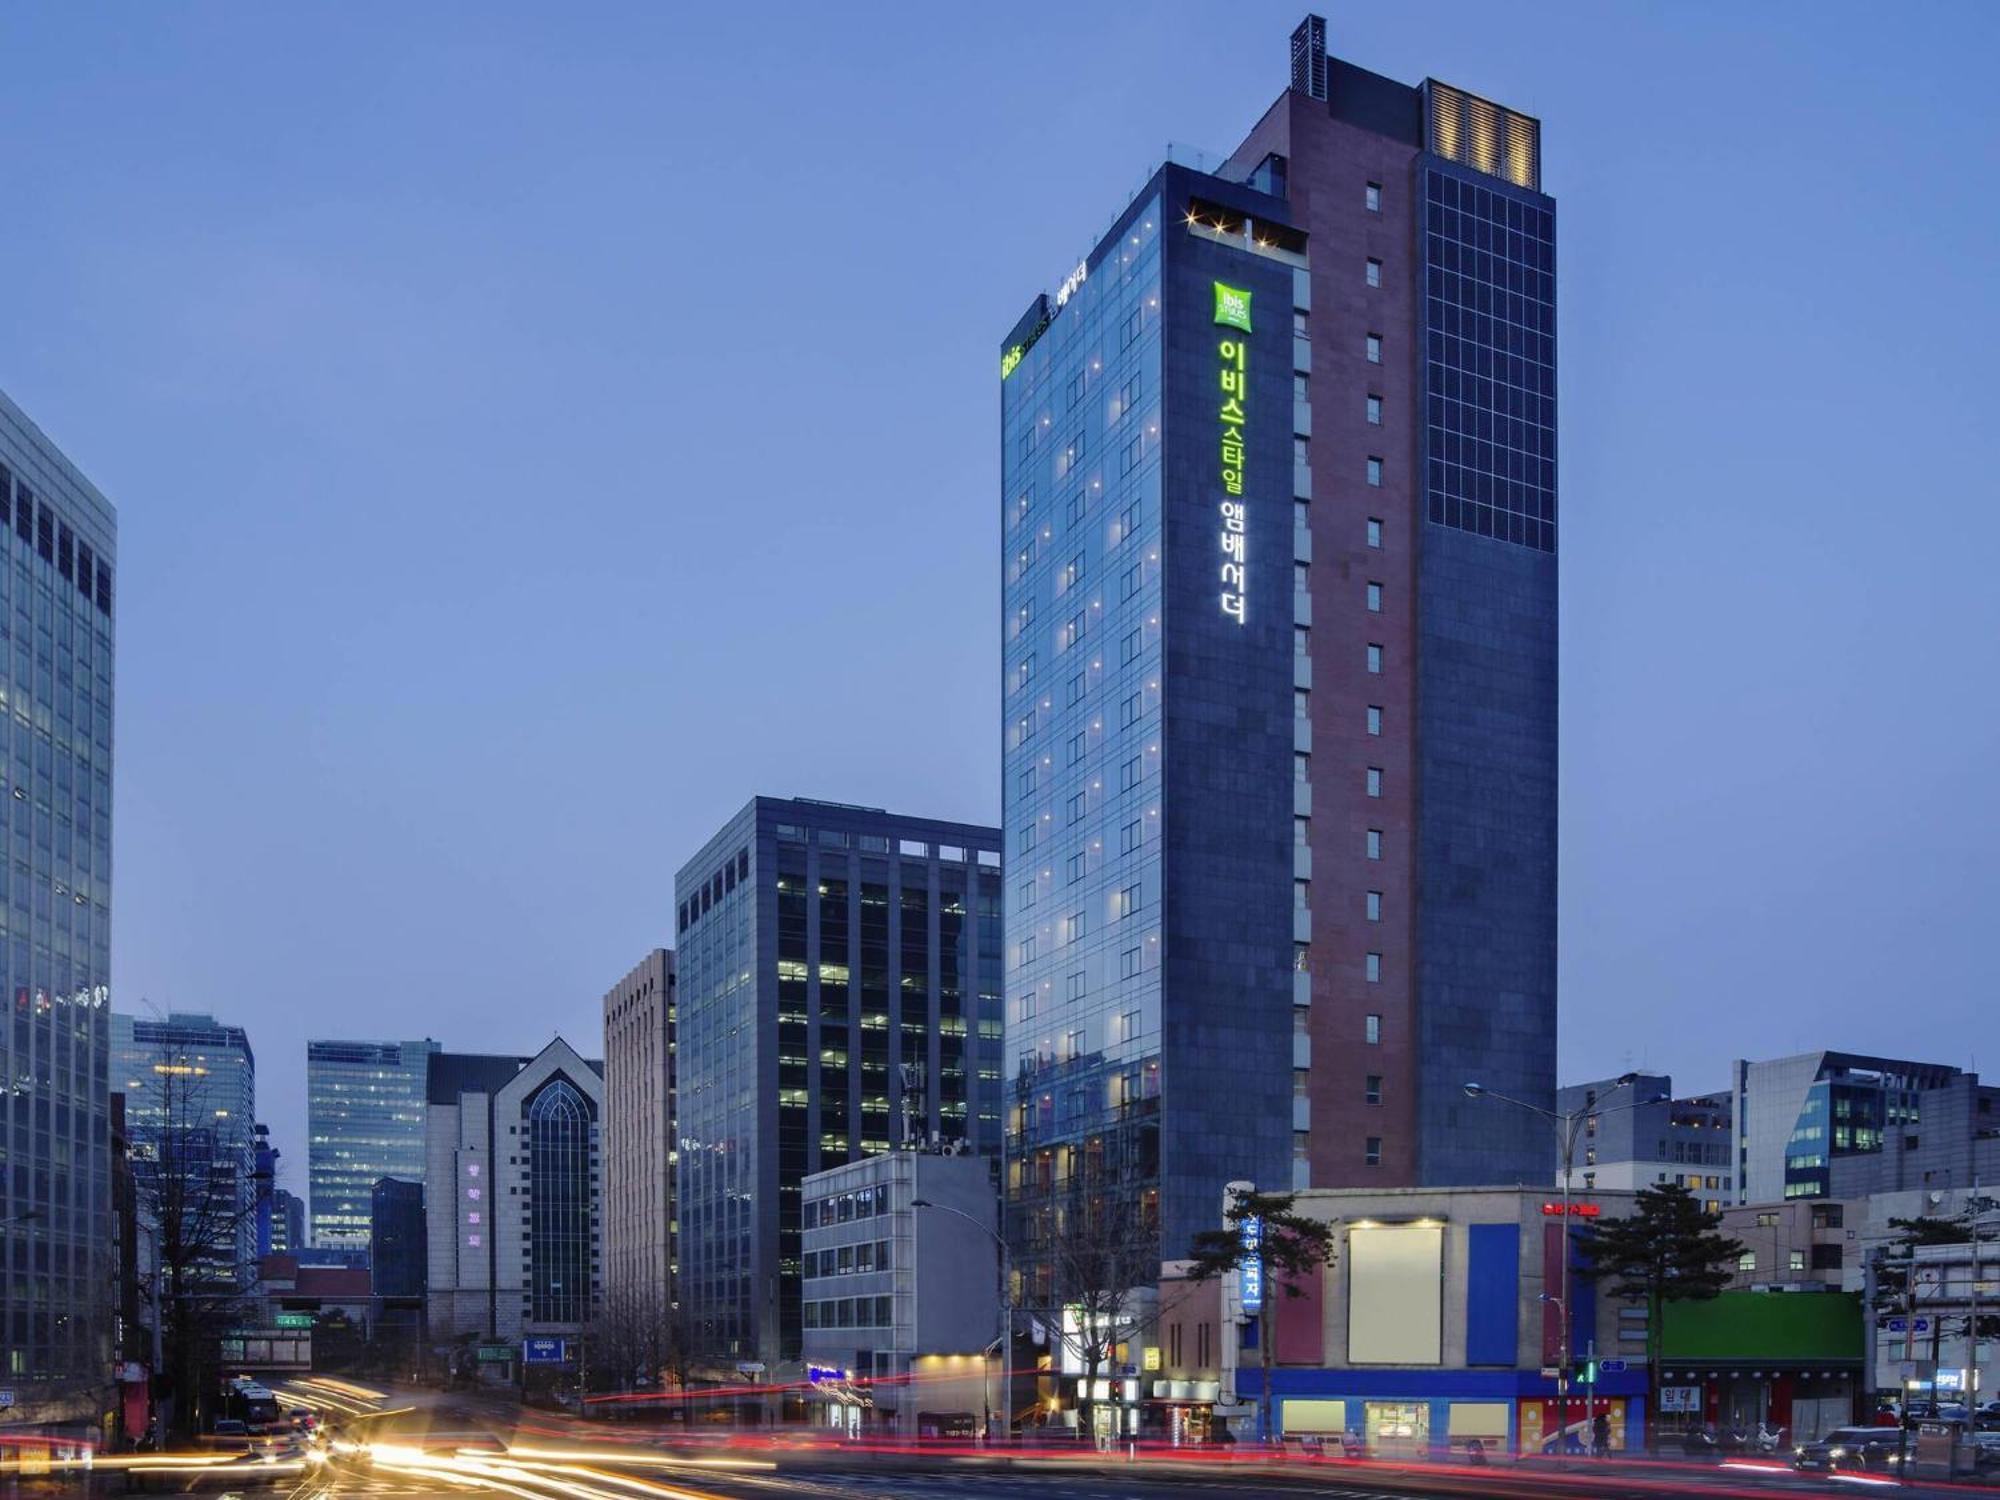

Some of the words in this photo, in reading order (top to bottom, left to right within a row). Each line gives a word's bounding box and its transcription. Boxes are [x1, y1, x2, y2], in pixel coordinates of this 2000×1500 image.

[1223, 292, 1244, 309] ibis
[1001, 345, 1021, 380] ibis
[1220, 501, 1245, 624] 앰배서더
